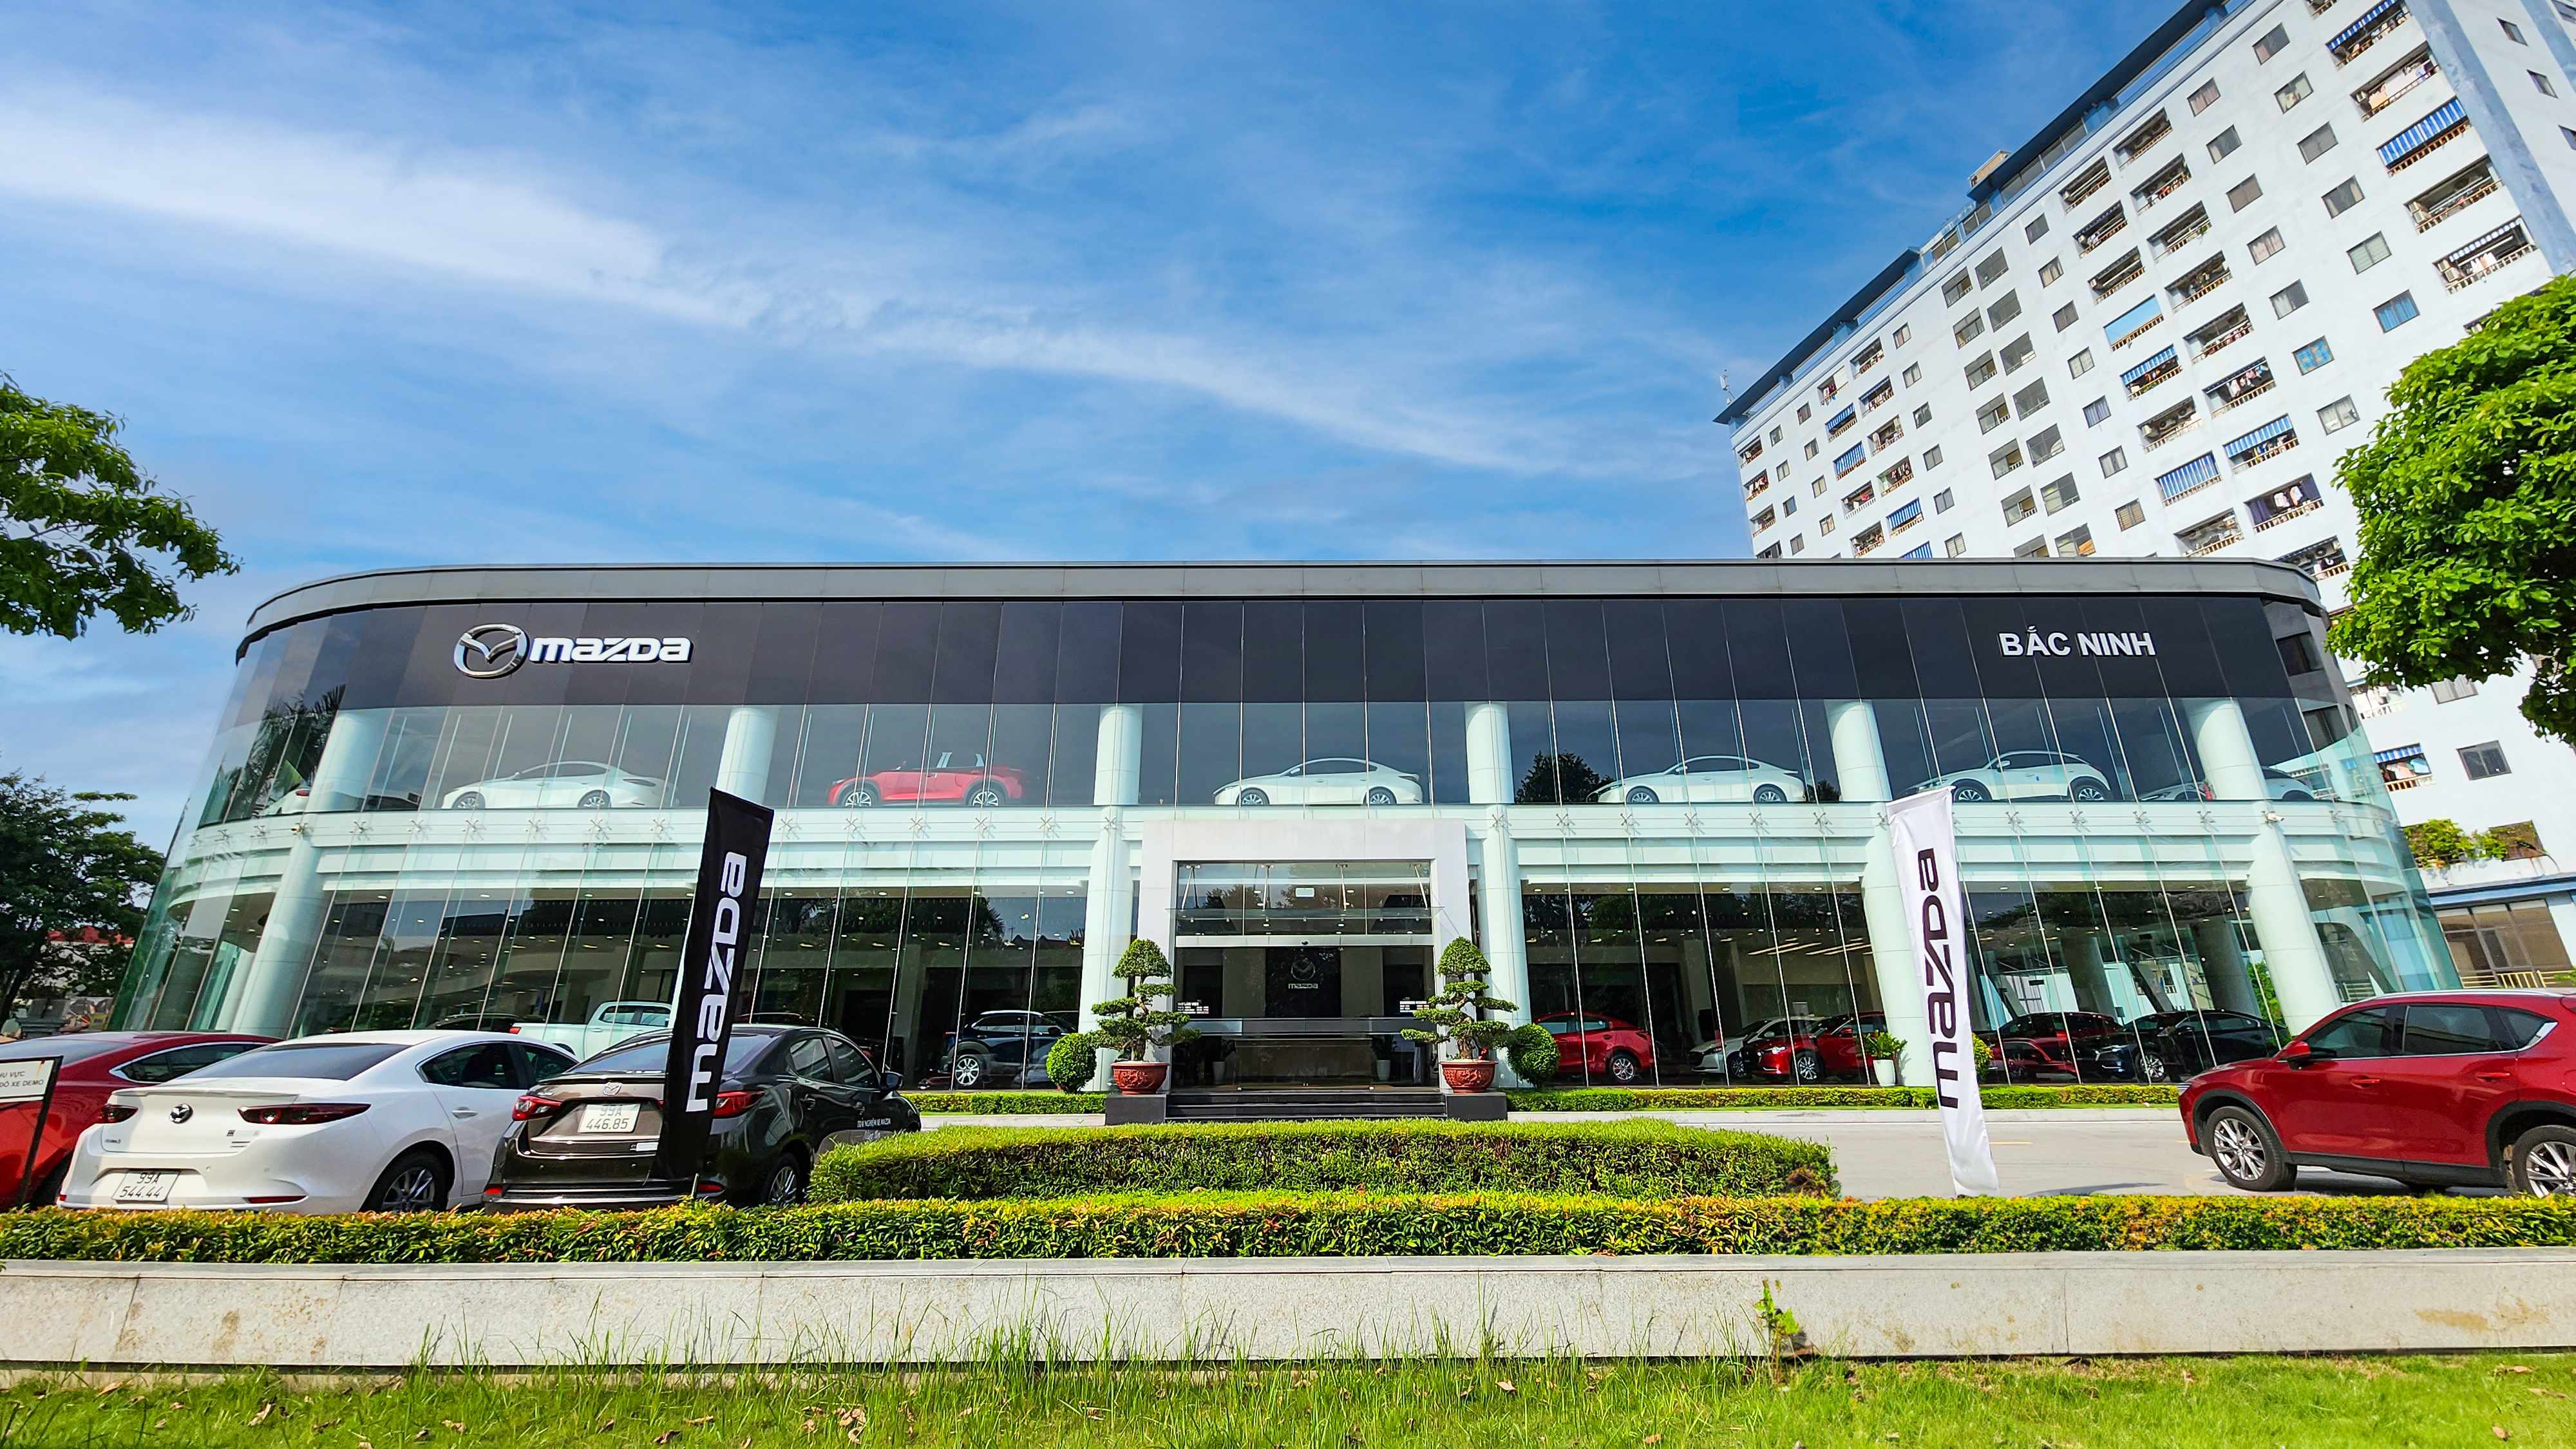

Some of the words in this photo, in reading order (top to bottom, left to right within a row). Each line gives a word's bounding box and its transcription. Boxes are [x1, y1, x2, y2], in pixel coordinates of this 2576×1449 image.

[529, 637, 692, 663] mazda
[1998, 625, 2071, 656] BẮC
[2076, 632, 2156, 656] NINH
[685, 851, 747, 1113] mazda
[1917, 848, 1958, 1110] mazda
[585, 1118, 629, 1130] 446.85
[136, 1172, 161, 1184] 99A
[119, 1186, 163, 1198] 544.44
